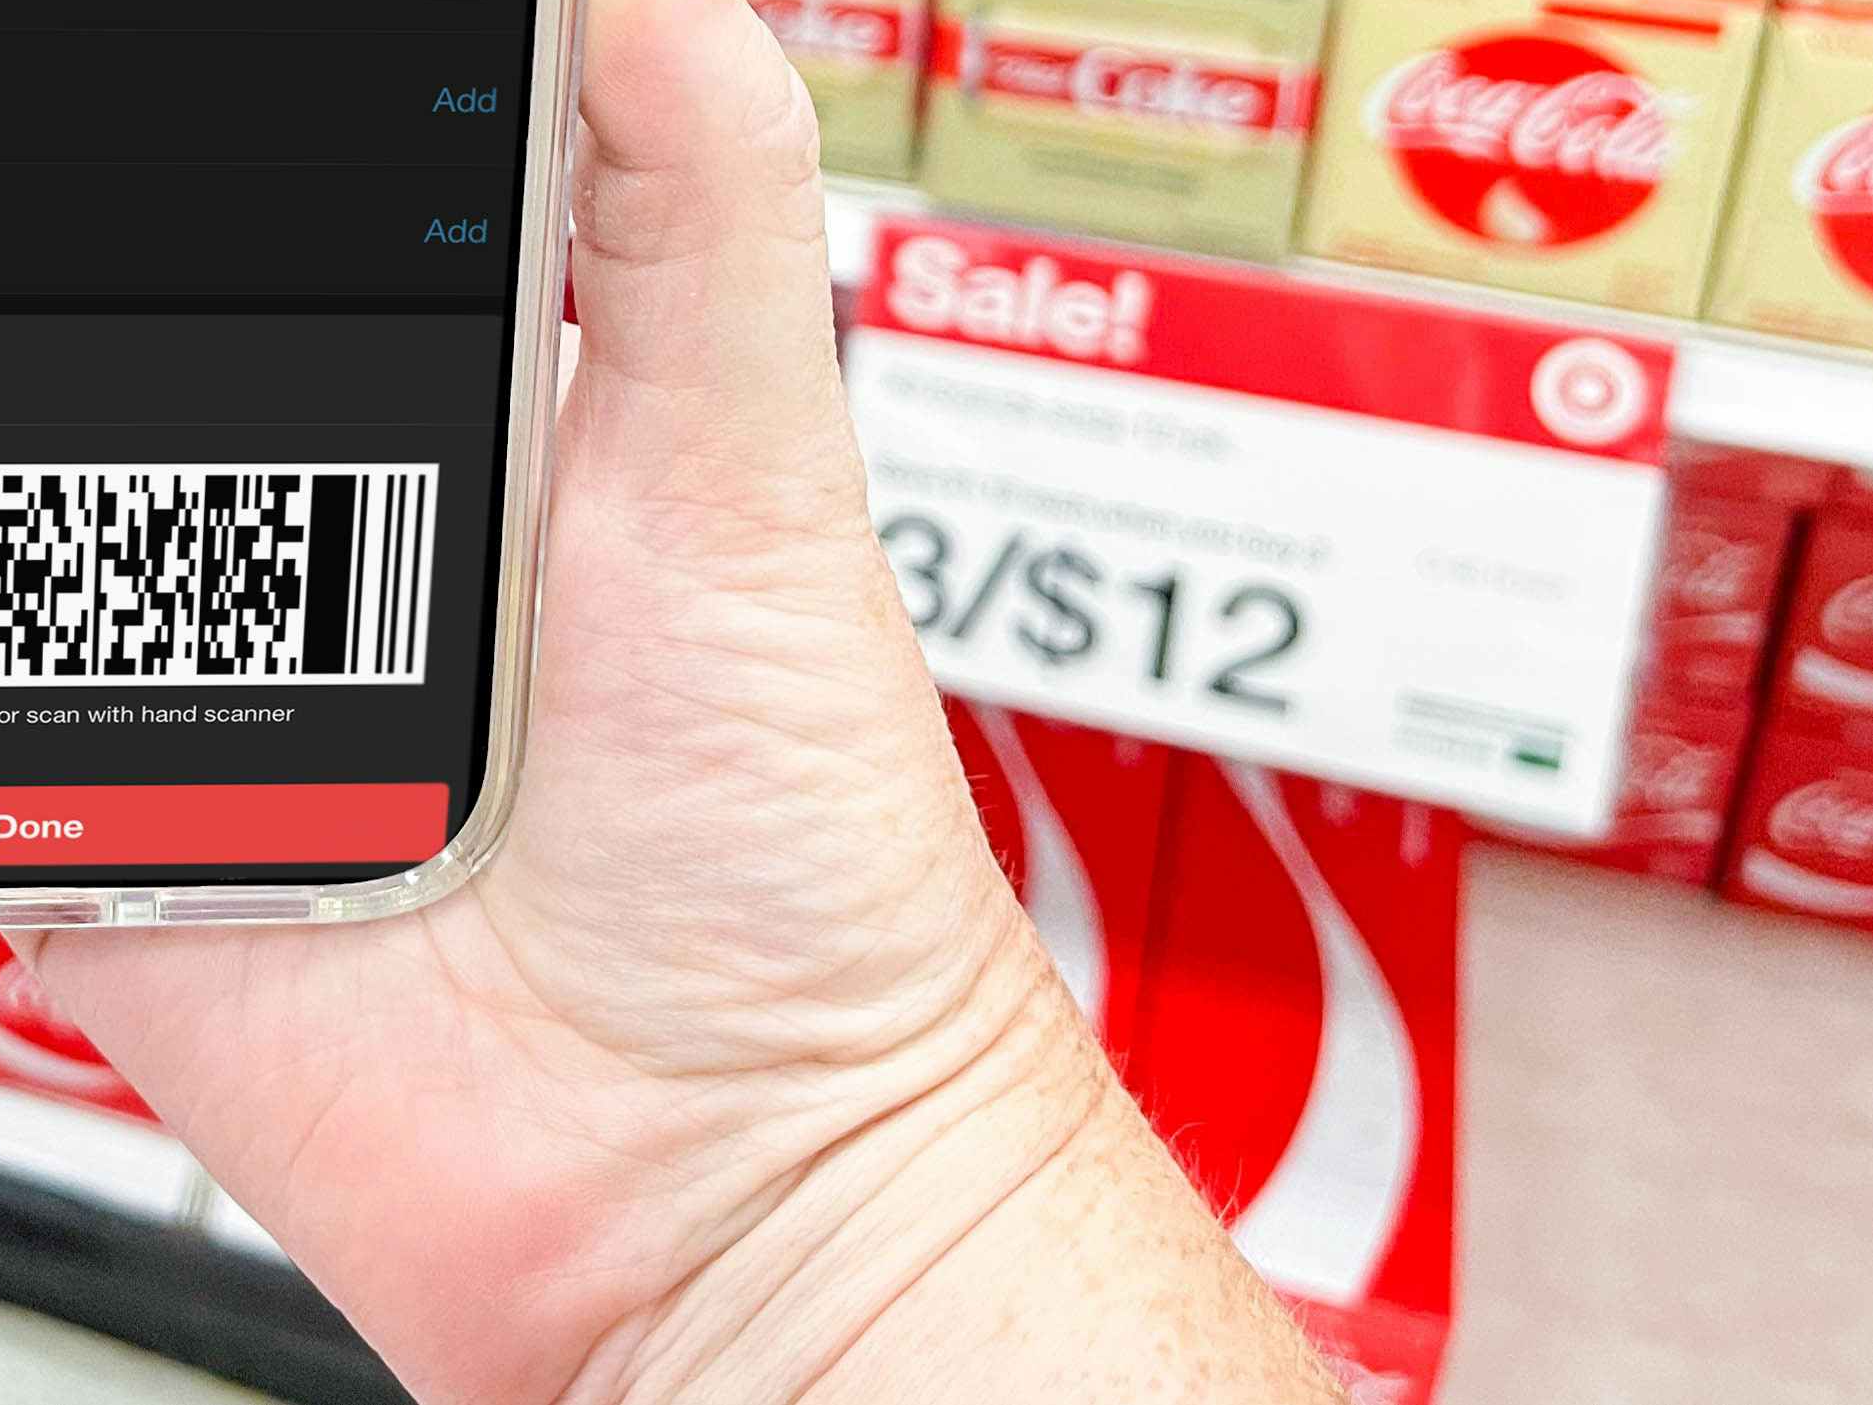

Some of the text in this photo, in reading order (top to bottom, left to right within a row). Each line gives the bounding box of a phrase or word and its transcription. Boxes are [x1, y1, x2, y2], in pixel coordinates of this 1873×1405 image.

[432, 87, 496, 113] Add
[1071, 45, 1261, 129] Coke
[424, 219, 487, 243] Add
[888, 236, 1153, 364] Sale!
[876, 510, 1306, 716] 3/$12
[27, 710, 79, 723] scan
[88, 706, 133, 722] with
[142, 705, 196, 722] hand
[204, 709, 294, 722] scanner
